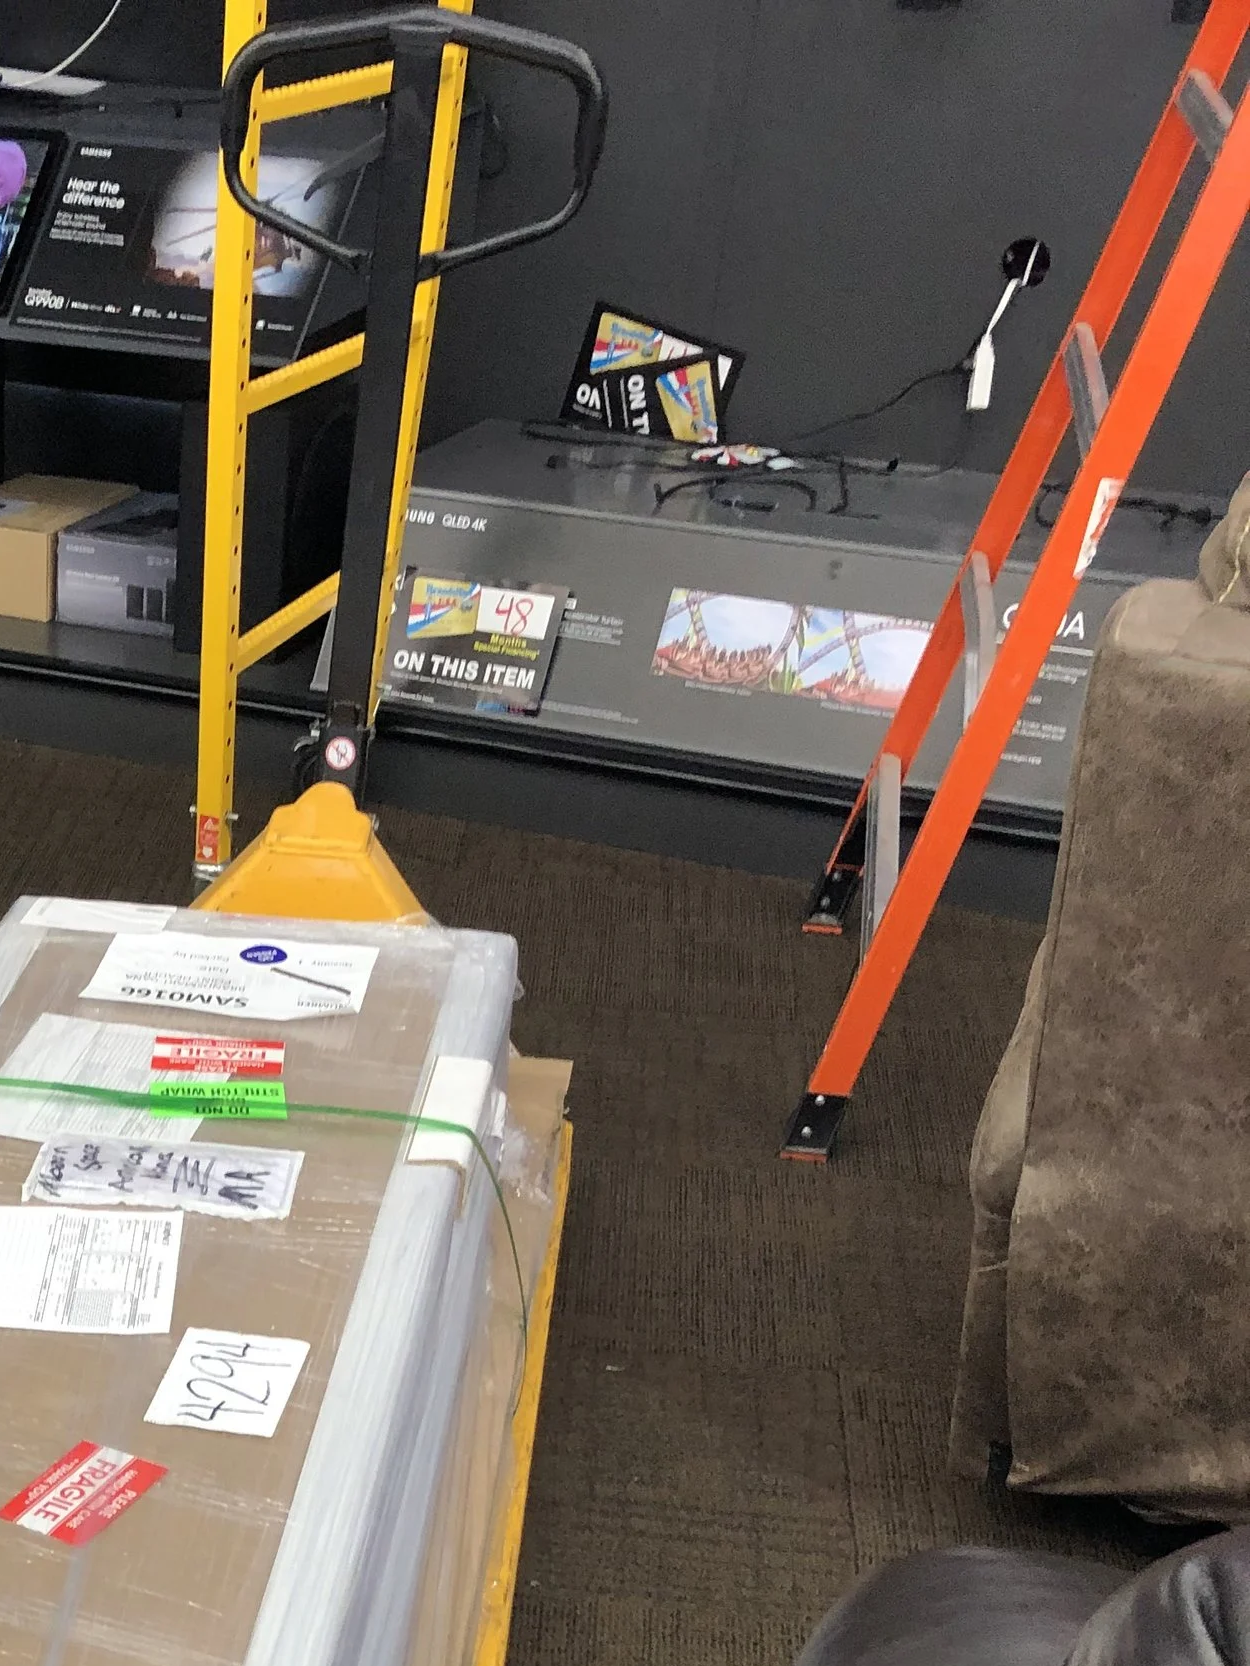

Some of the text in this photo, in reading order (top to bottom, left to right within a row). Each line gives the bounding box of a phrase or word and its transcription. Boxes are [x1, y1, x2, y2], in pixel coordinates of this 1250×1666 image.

[67, 177, 120, 194] Hear the
[62, 191, 125, 209] difference
[441, 513, 471, 530] QLED
[472, 518, 488, 533] 4K
[495, 593, 534, 638] 48
[393, 650, 425, 673] ON
[431, 654, 480, 681] THIS
[483, 663, 536, 690] ITEM
[120, 985, 250, 1010] SAM0166
[171, 1047, 267, 1060] FRAGILE
[160, 1086, 280, 1097] STRETCH WRAP
[228, 1106, 250, 1116] DO
[33, 1458, 118, 1522] FRAGILE
